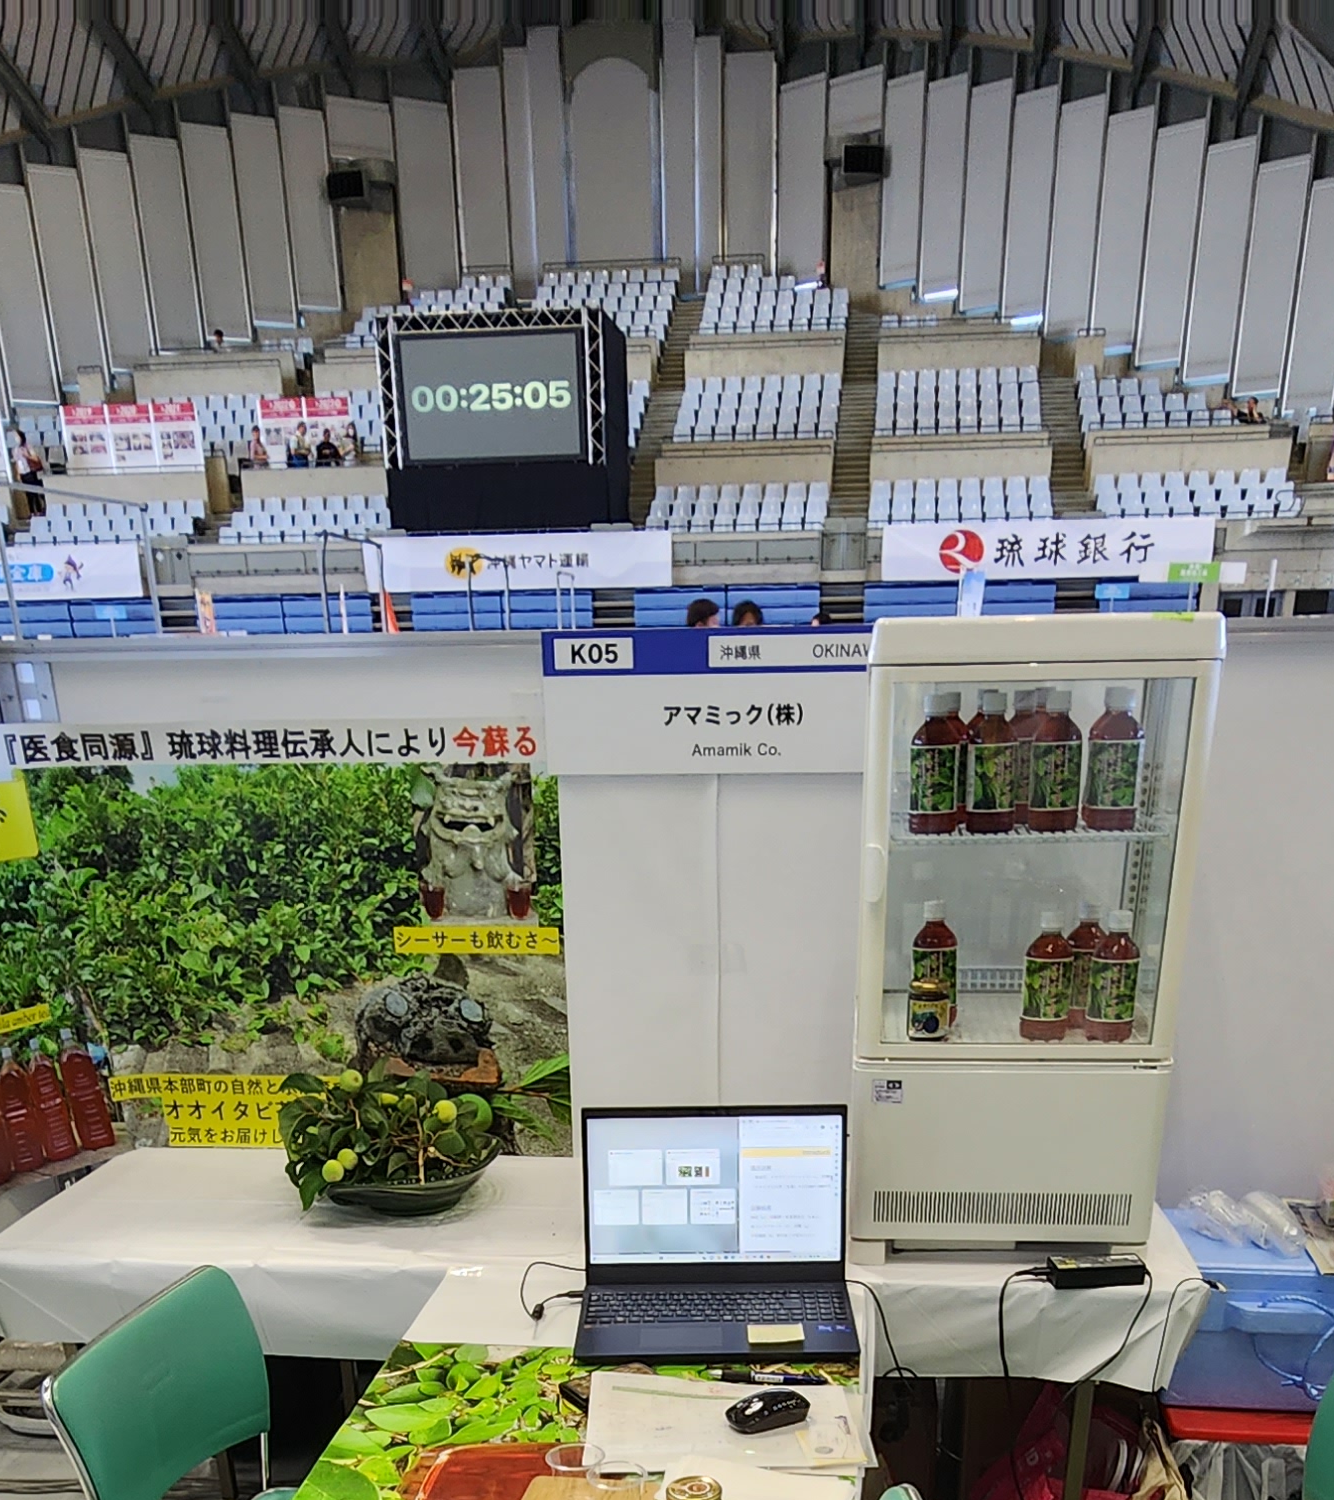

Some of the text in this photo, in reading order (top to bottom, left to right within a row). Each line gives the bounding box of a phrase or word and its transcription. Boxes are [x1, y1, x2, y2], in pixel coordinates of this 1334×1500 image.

[411, 380, 572, 413] 00:25:05
[994, 531, 1156, 568] 琉球銀行
[570, 643, 619, 665] K05
[719, 644, 761, 660] 沖縄県
[691, 743, 782, 757] Amamik Co.
